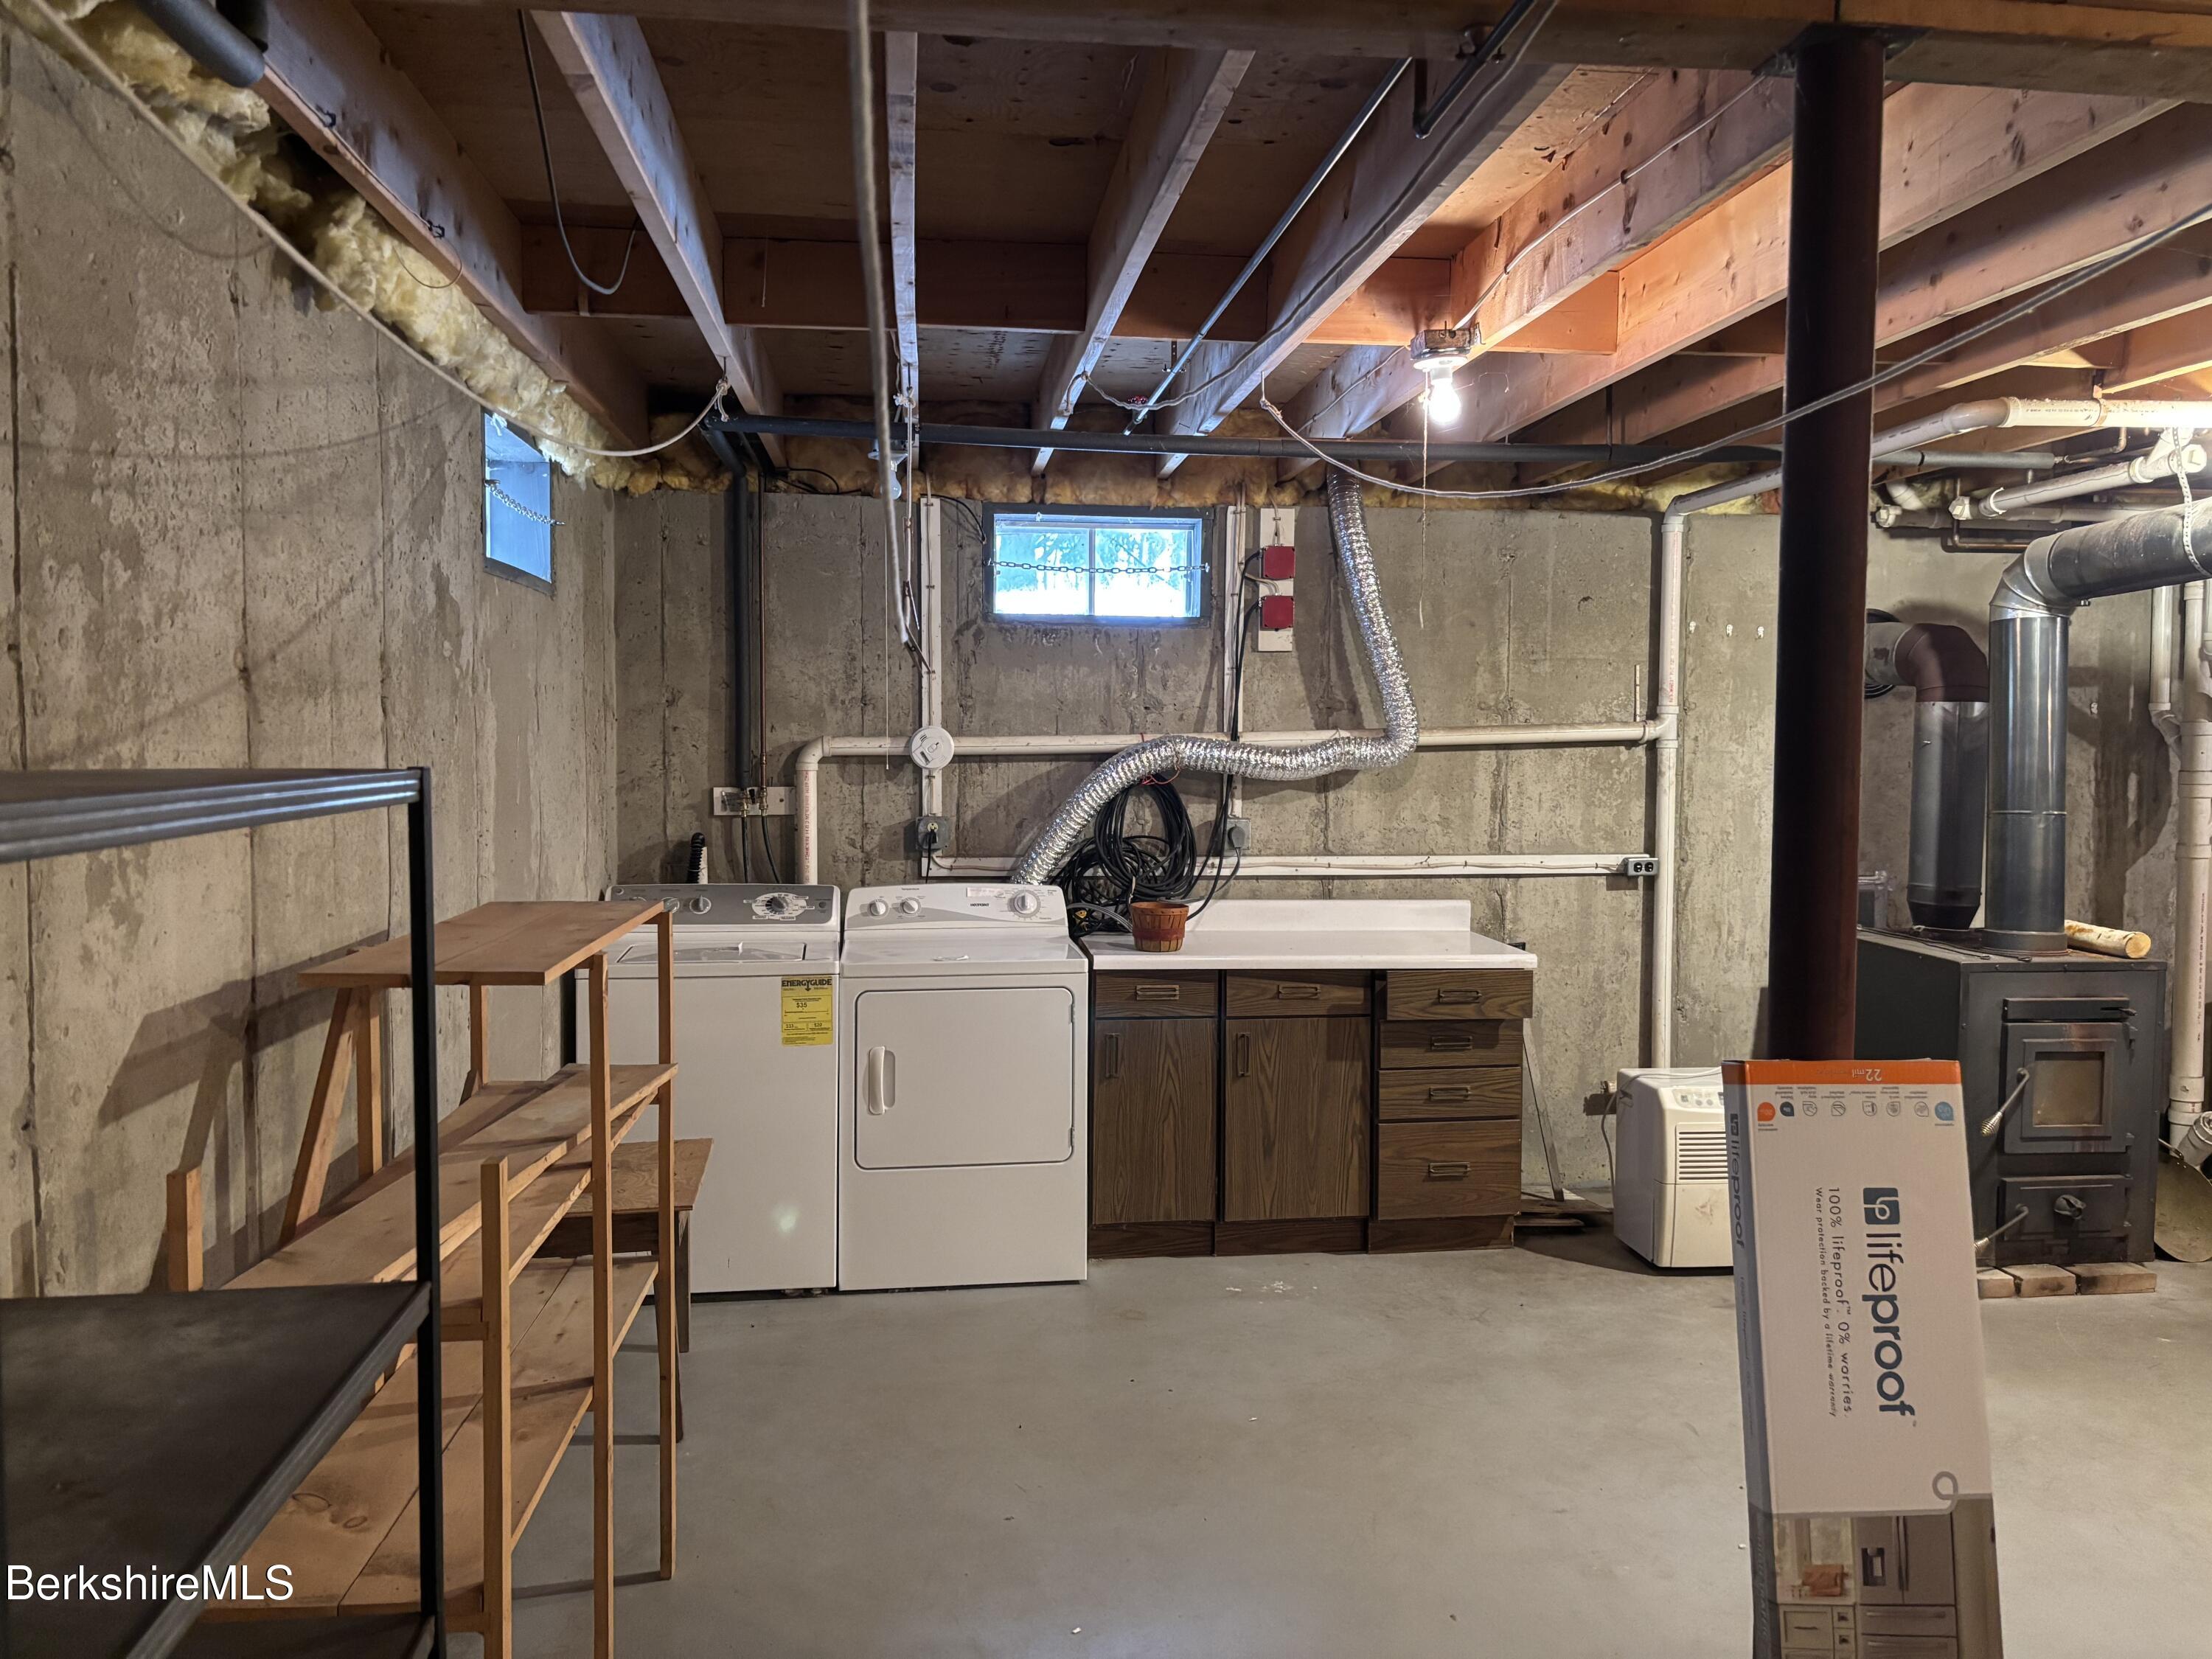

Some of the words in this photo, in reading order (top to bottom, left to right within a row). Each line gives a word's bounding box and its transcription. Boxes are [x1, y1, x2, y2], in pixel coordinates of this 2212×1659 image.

[782, 978, 832, 988] ENERGYGUIDE
[1851, 1068, 1865, 1079] mil
[1865, 1068, 1882, 1082] 22
[1731, 1140, 1745, 1249] lifeproof
[1815, 1216, 1826, 1266] protection
[1829, 1186, 1843, 1228] 100%
[1837, 1321, 1851, 1345] 0%
[1820, 1268, 1829, 1304] backed
[1823, 1307, 1832, 1321] by
[1861, 1233, 1916, 1416] lifeproof
[1825, 1332, 1834, 1370] lifetime
